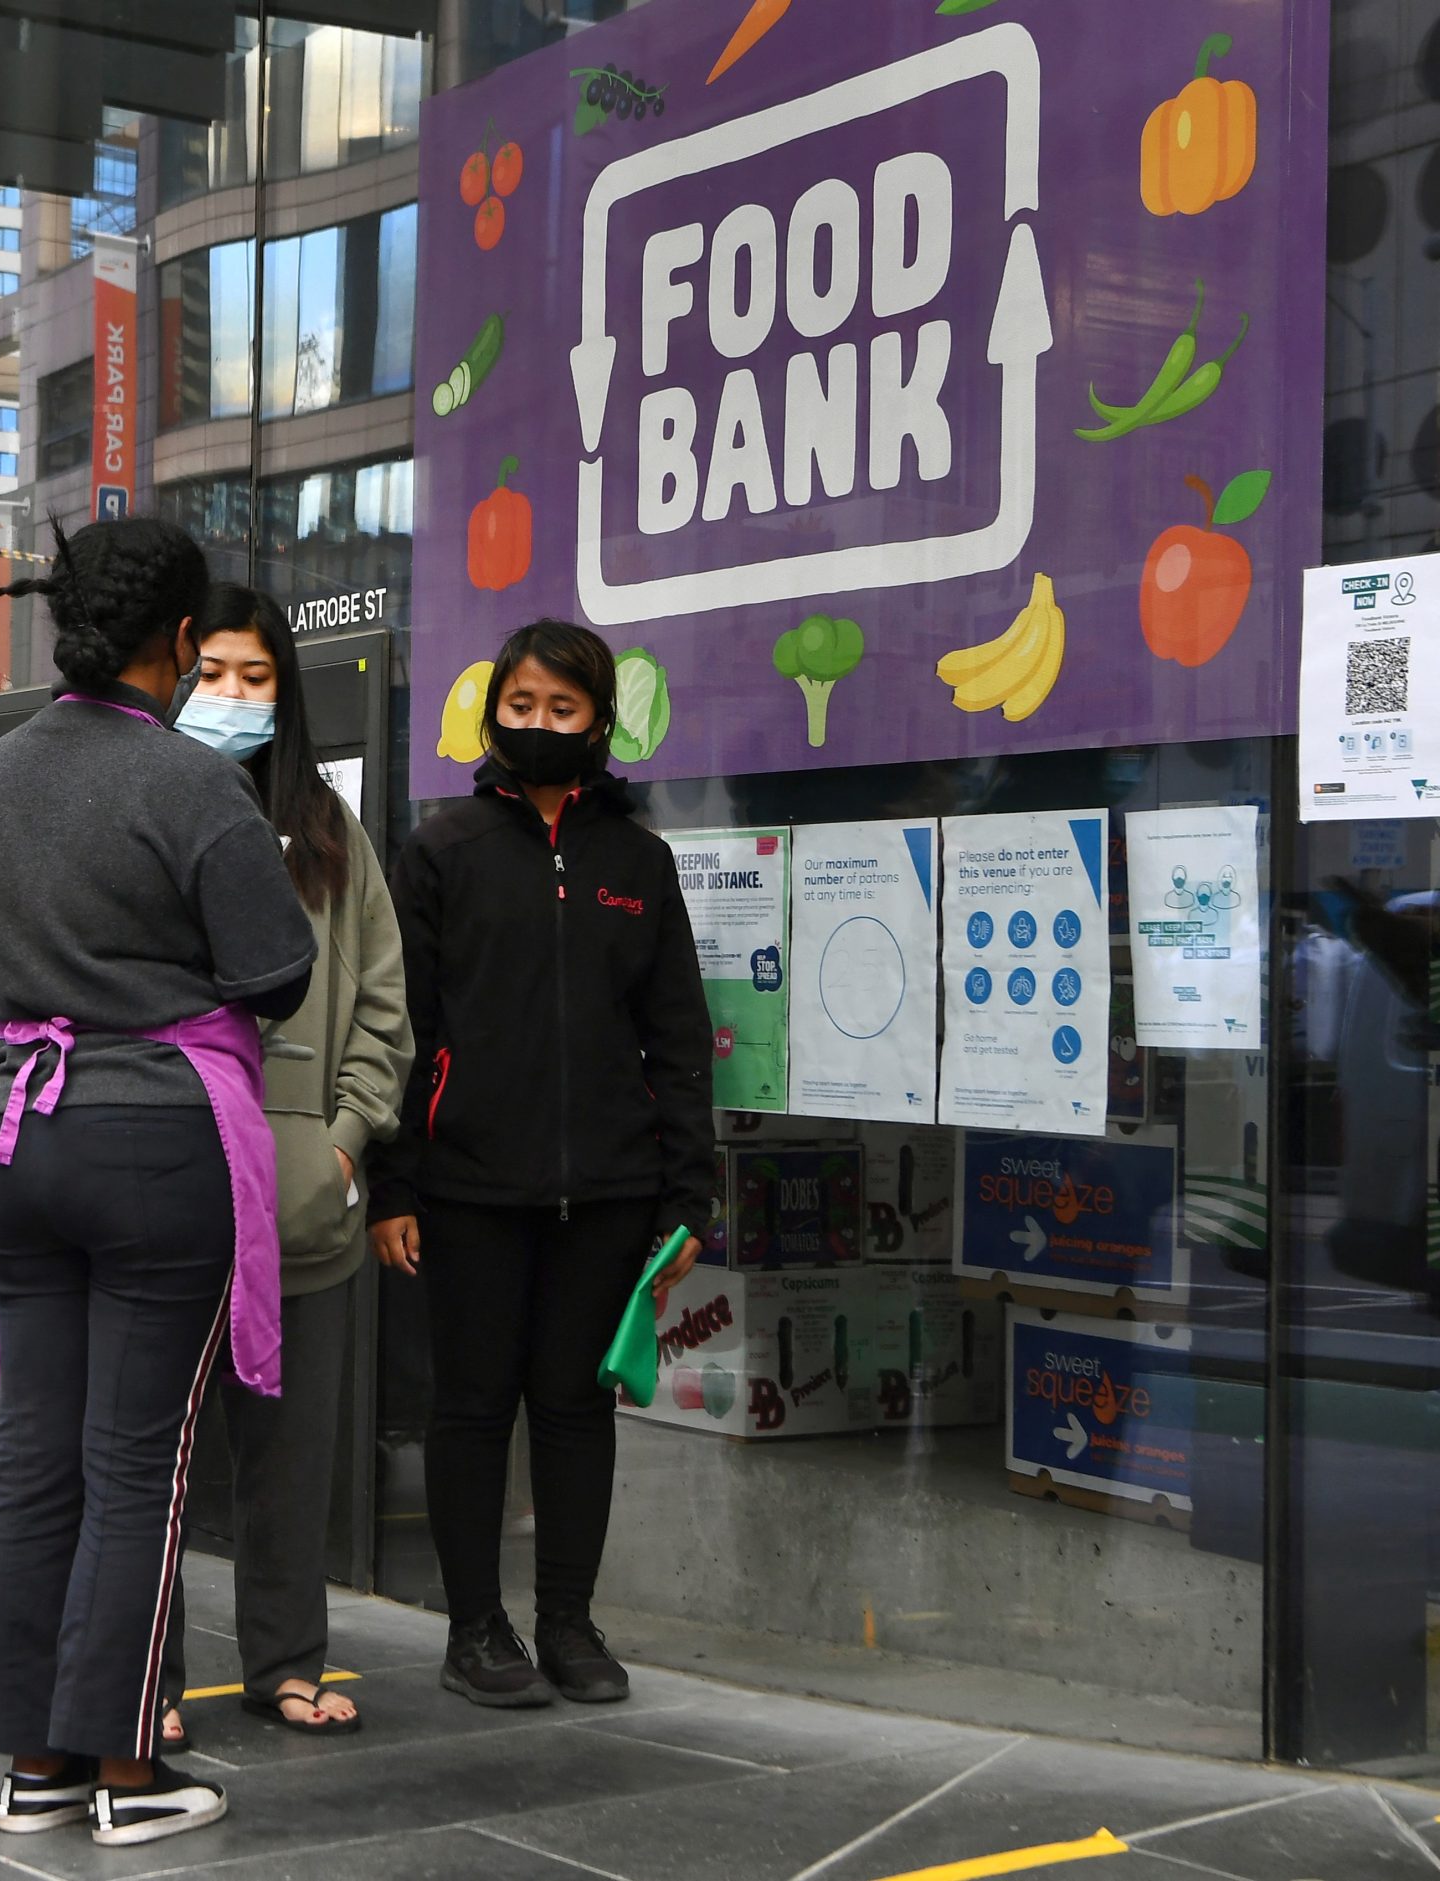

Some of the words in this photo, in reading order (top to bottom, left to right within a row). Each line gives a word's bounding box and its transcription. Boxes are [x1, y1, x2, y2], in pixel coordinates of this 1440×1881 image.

[642, 152, 952, 376] FOOD
[638, 320, 951, 534] BANK
[1342, 576, 1389, 591] CHECK-IN
[287, 593, 361, 633] LATROBE
[365, 588, 387, 620] ST
[1356, 595, 1374, 608] NOW
[804, 859, 822, 870] Our
[825, 857, 878, 870] maximum
[959, 850, 995, 863] Please
[998, 849, 1013, 861] do
[1015, 849, 1035, 861] not
[1037, 848, 1069, 860] enter
[708, 871, 763, 890] DISTANCE.
[804, 873, 844, 886] number
[846, 872, 858, 884] of
[859, 873, 900, 886] patrons
[959, 867, 980, 879] this
[982, 867, 1016, 878] venue
[1019, 864, 1027, 877] if
[1029, 866, 1050, 879] you
[1053, 866, 1073, 876] are
[804, 890, 815, 901] at
[817, 892, 836, 902] any
[839, 889, 861, 900] time
[864, 888, 876, 900] is:
[958, 881, 1035, 897] experiencing:
[1164, 923, 1181, 931] KEEP
[1000, 1156, 1062, 1180] sweet
[977, 1174, 1115, 1214] squeeze
[1048, 1232, 1094, 1254] juicing
[1095, 1239, 1153, 1258] oranges
[782, 1276, 840, 1293] Capsicums
[656, 1294, 733, 1374] roduce
[1044, 1351, 1102, 1379] sweet
[1026, 1367, 1152, 1418] squeeze
[1090, 1431, 1132, 1455] juicing
